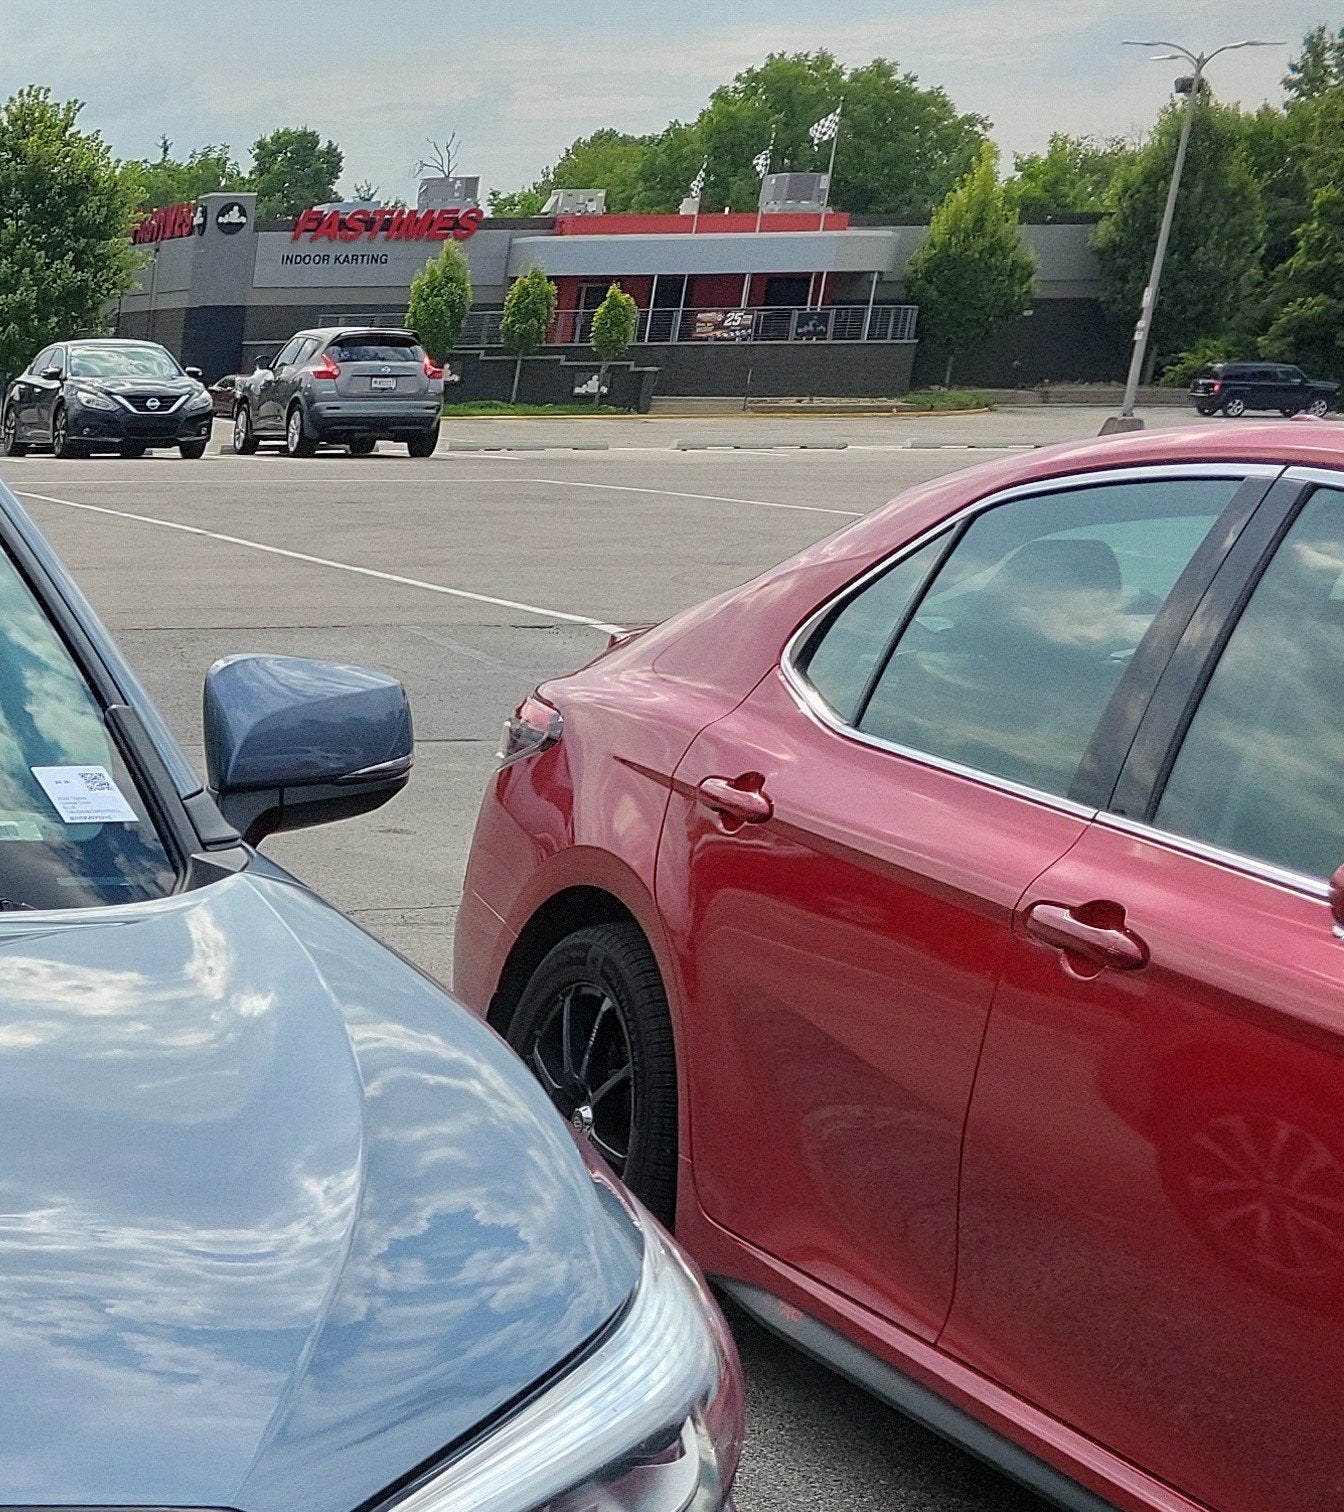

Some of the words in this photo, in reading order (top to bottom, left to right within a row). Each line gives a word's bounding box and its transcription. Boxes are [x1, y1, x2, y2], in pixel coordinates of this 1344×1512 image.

[291, 207, 484, 243] FASTIMES
[281, 254, 330, 265] INDOOR
[334, 253, 389, 265] KARTING
[723, 312, 745, 326] 25
